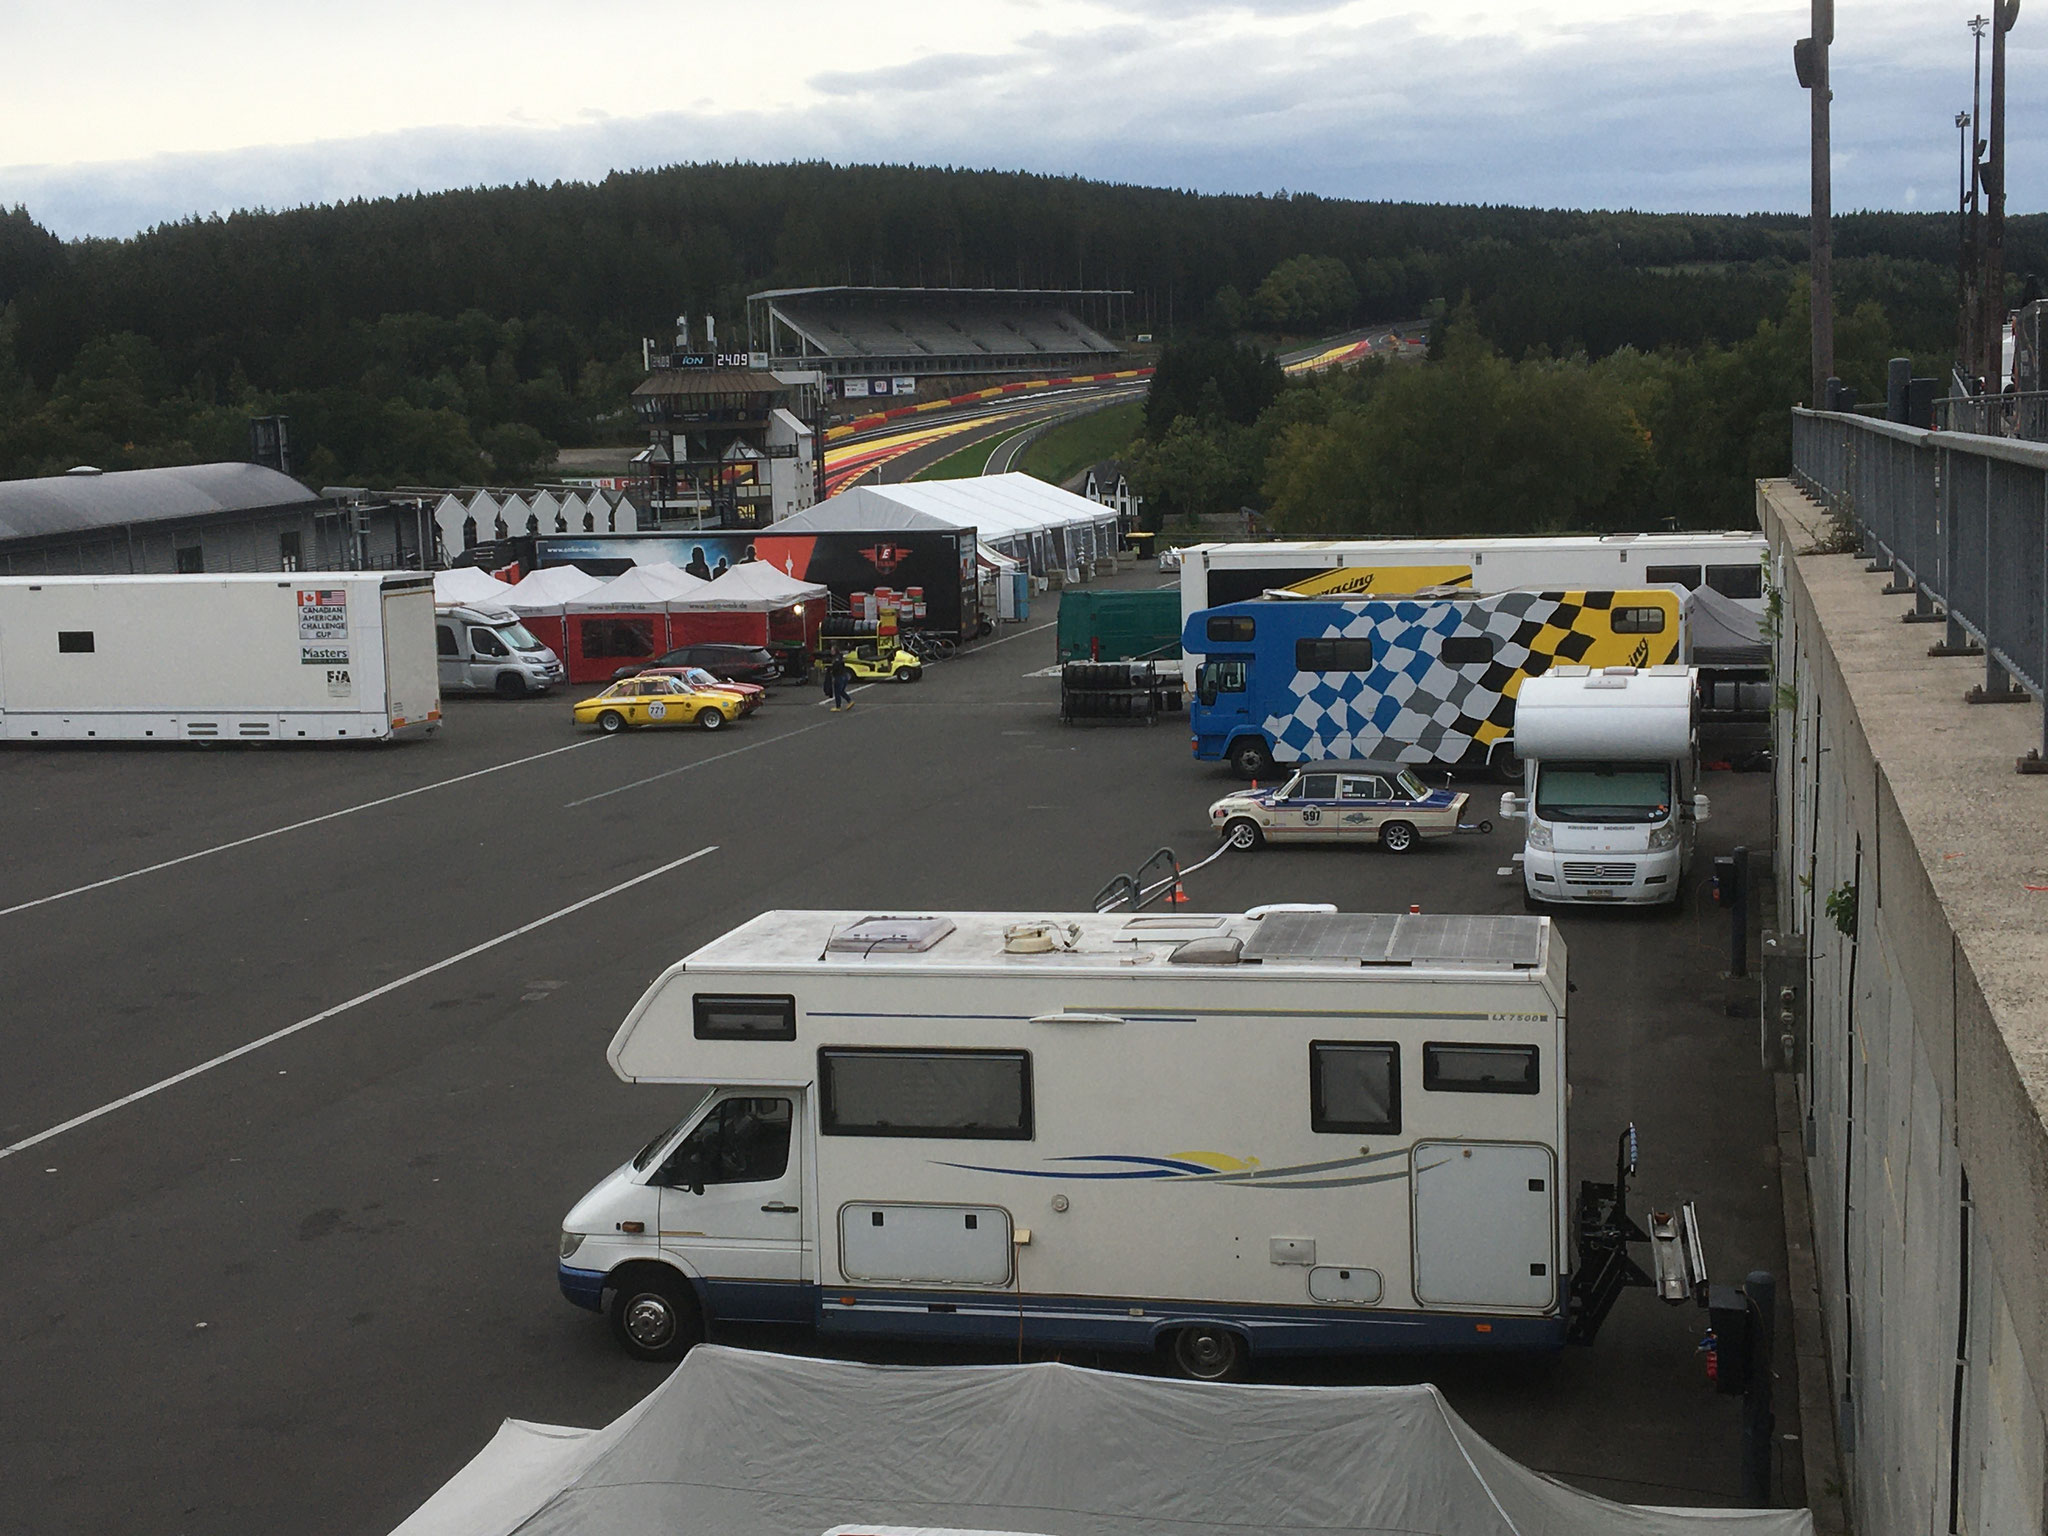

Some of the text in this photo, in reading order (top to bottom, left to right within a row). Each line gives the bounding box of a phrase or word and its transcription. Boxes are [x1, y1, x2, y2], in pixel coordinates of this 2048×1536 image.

[717, 354, 748, 366] 24.09
[881, 549, 892, 559] E
[301, 622, 345, 630] CHALLENGE
[302, 648, 347, 658] Masters
[650, 706, 664, 715] 771
[1302, 810, 1321, 822] 597
[1510, 1014, 1538, 1022] 7500
